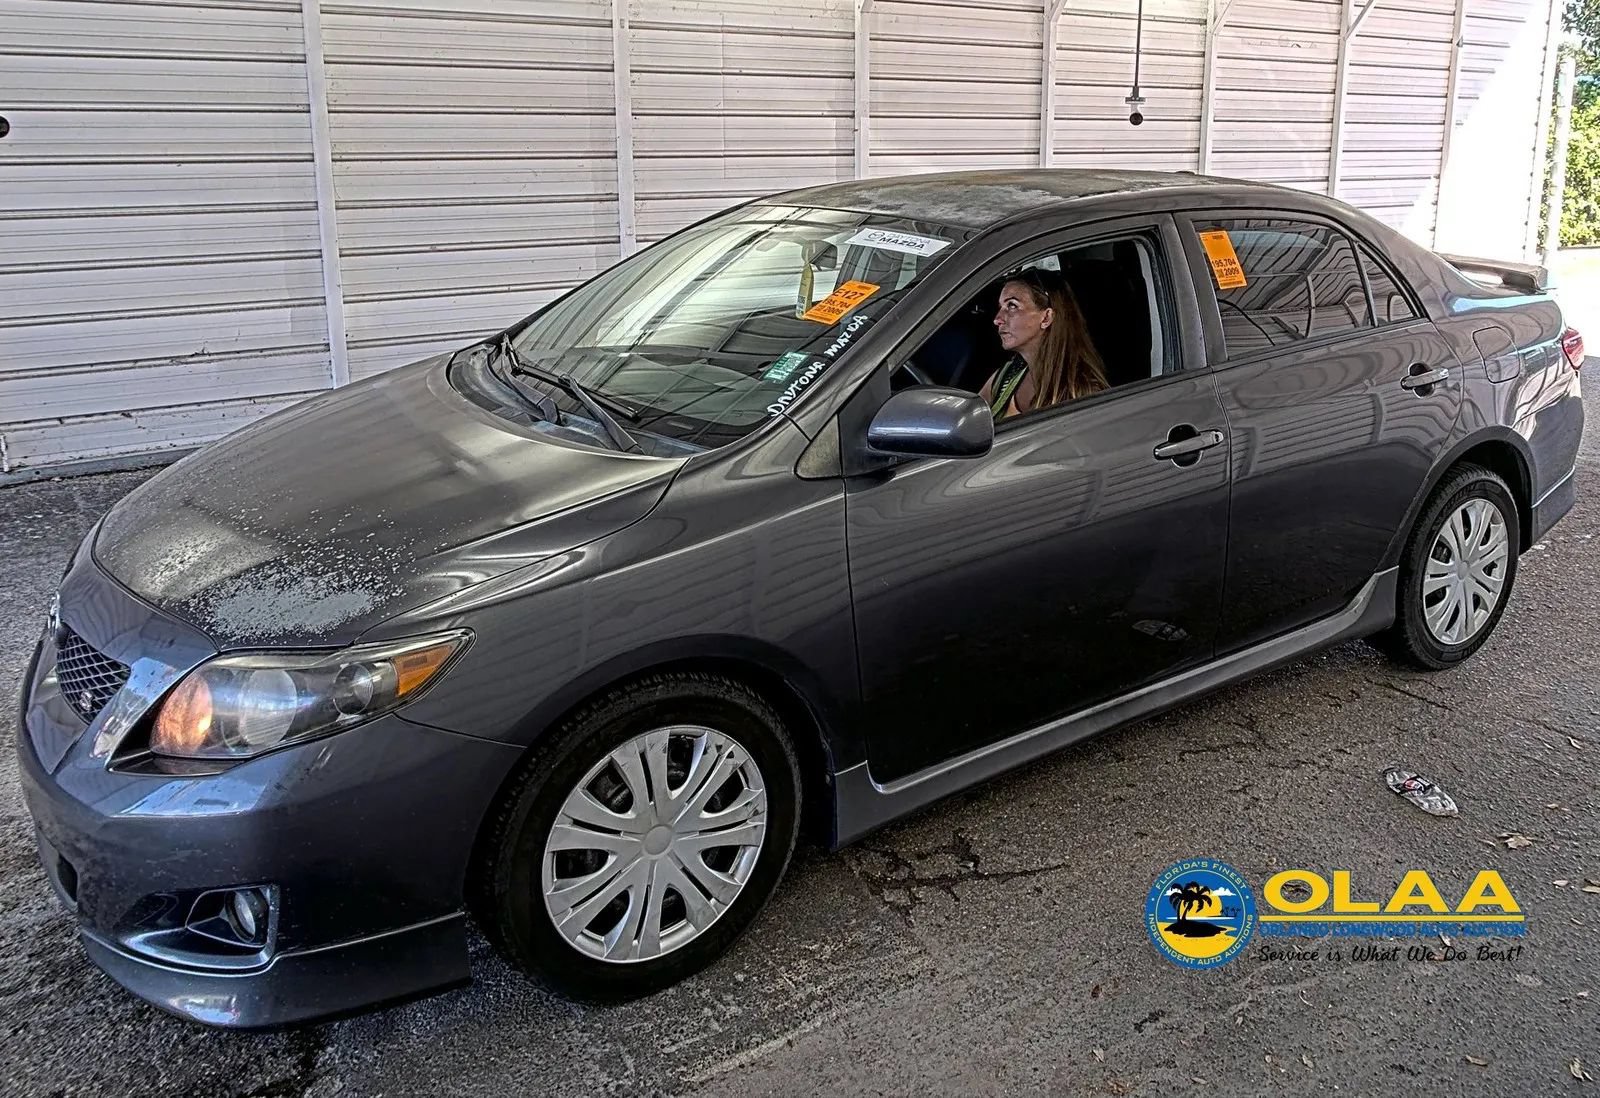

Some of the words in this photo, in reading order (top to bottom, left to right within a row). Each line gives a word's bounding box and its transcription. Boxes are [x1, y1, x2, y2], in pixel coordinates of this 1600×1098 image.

[878, 237, 925, 249] MAZDA
[1223, 266, 1240, 276] 2009
[823, 315, 868, 357] MAZDA
